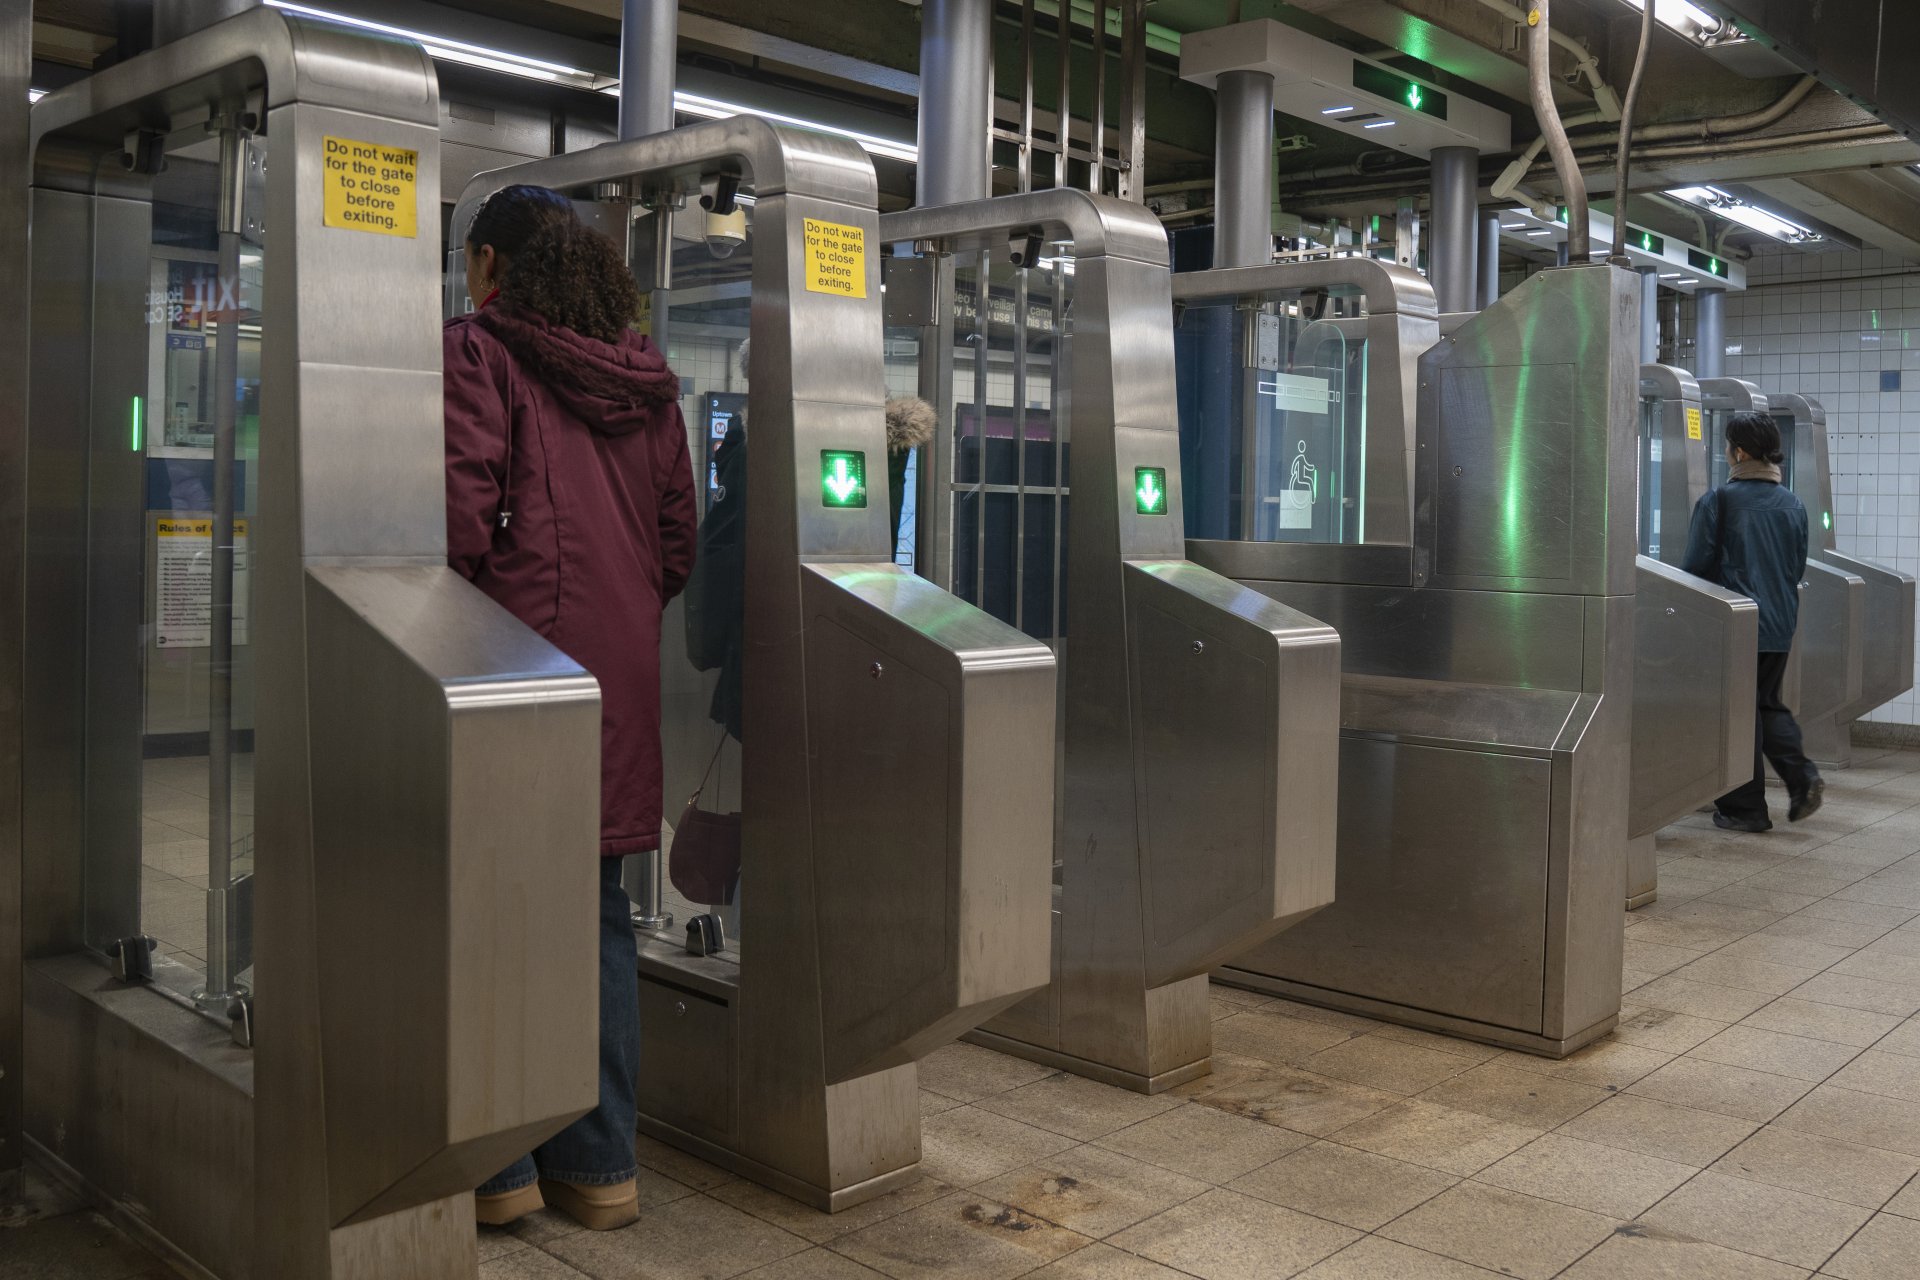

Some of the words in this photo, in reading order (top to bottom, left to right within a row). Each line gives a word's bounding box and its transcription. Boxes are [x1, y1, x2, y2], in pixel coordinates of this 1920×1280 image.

[327, 140, 348, 155] Do
[353, 147, 378, 160] not
[382, 152, 415, 166] wait
[326, 156, 348, 171] for
[352, 161, 376, 176] the
[381, 168, 414, 182] gate
[341, 175, 356, 188] to
[360, 179, 401, 195] close
[346, 192, 395, 211] before
[343, 210, 398, 230] exiting.
[806, 221, 820, 233] Do
[823, 227, 840, 237] not
[842, 230, 862, 241] wait
[806, 235, 820, 246] for
[823, 238, 839, 249] the
[841, 243, 863, 253] gate
[815, 250, 826, 260] to
[828, 252, 855, 264] close
[819, 263, 852, 277] before
[818, 277, 854, 292] exiting.
[993, 312, 1010, 323] use
[1026, 315, 1041, 328] his
[716, 425, 725, 433] M
[159, 523, 192, 533] Rules
[195, 524, 208, 533] of
